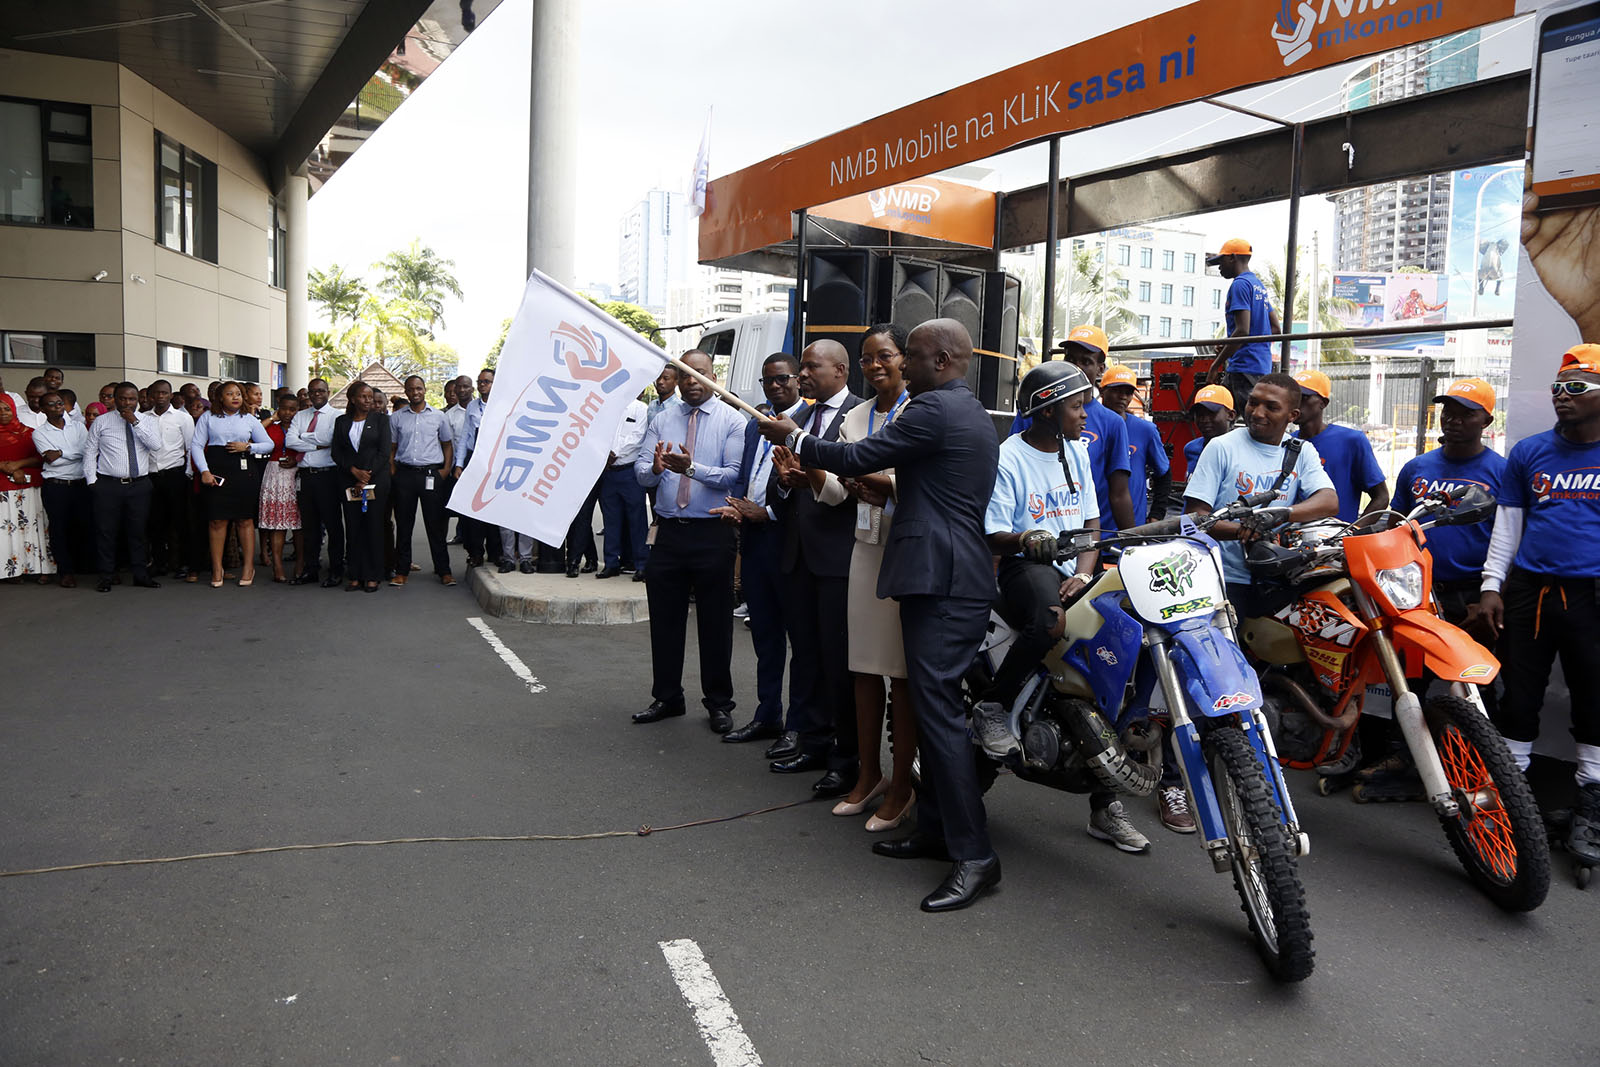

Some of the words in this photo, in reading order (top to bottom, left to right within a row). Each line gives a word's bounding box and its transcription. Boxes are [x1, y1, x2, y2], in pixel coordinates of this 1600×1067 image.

[1317, 0, 1443, 49] mkononi
[1564, 30, 1595, 43] Fungua
[830, 147, 878, 187] NMB
[884, 121, 958, 171] Mobile
[965, 111, 995, 144] na
[1003, 80, 1061, 130] KLiK
[1067, 62, 1146, 110] sasa
[1159, 33, 1197, 84] ni
[887, 187, 932, 213] NMB
[1045, 490, 1080, 509] NMB
[1551, 490, 1600, 500] mkonon
[1308, 648, 1339, 667] DHL
[1216, 695, 1252, 708] IMS
